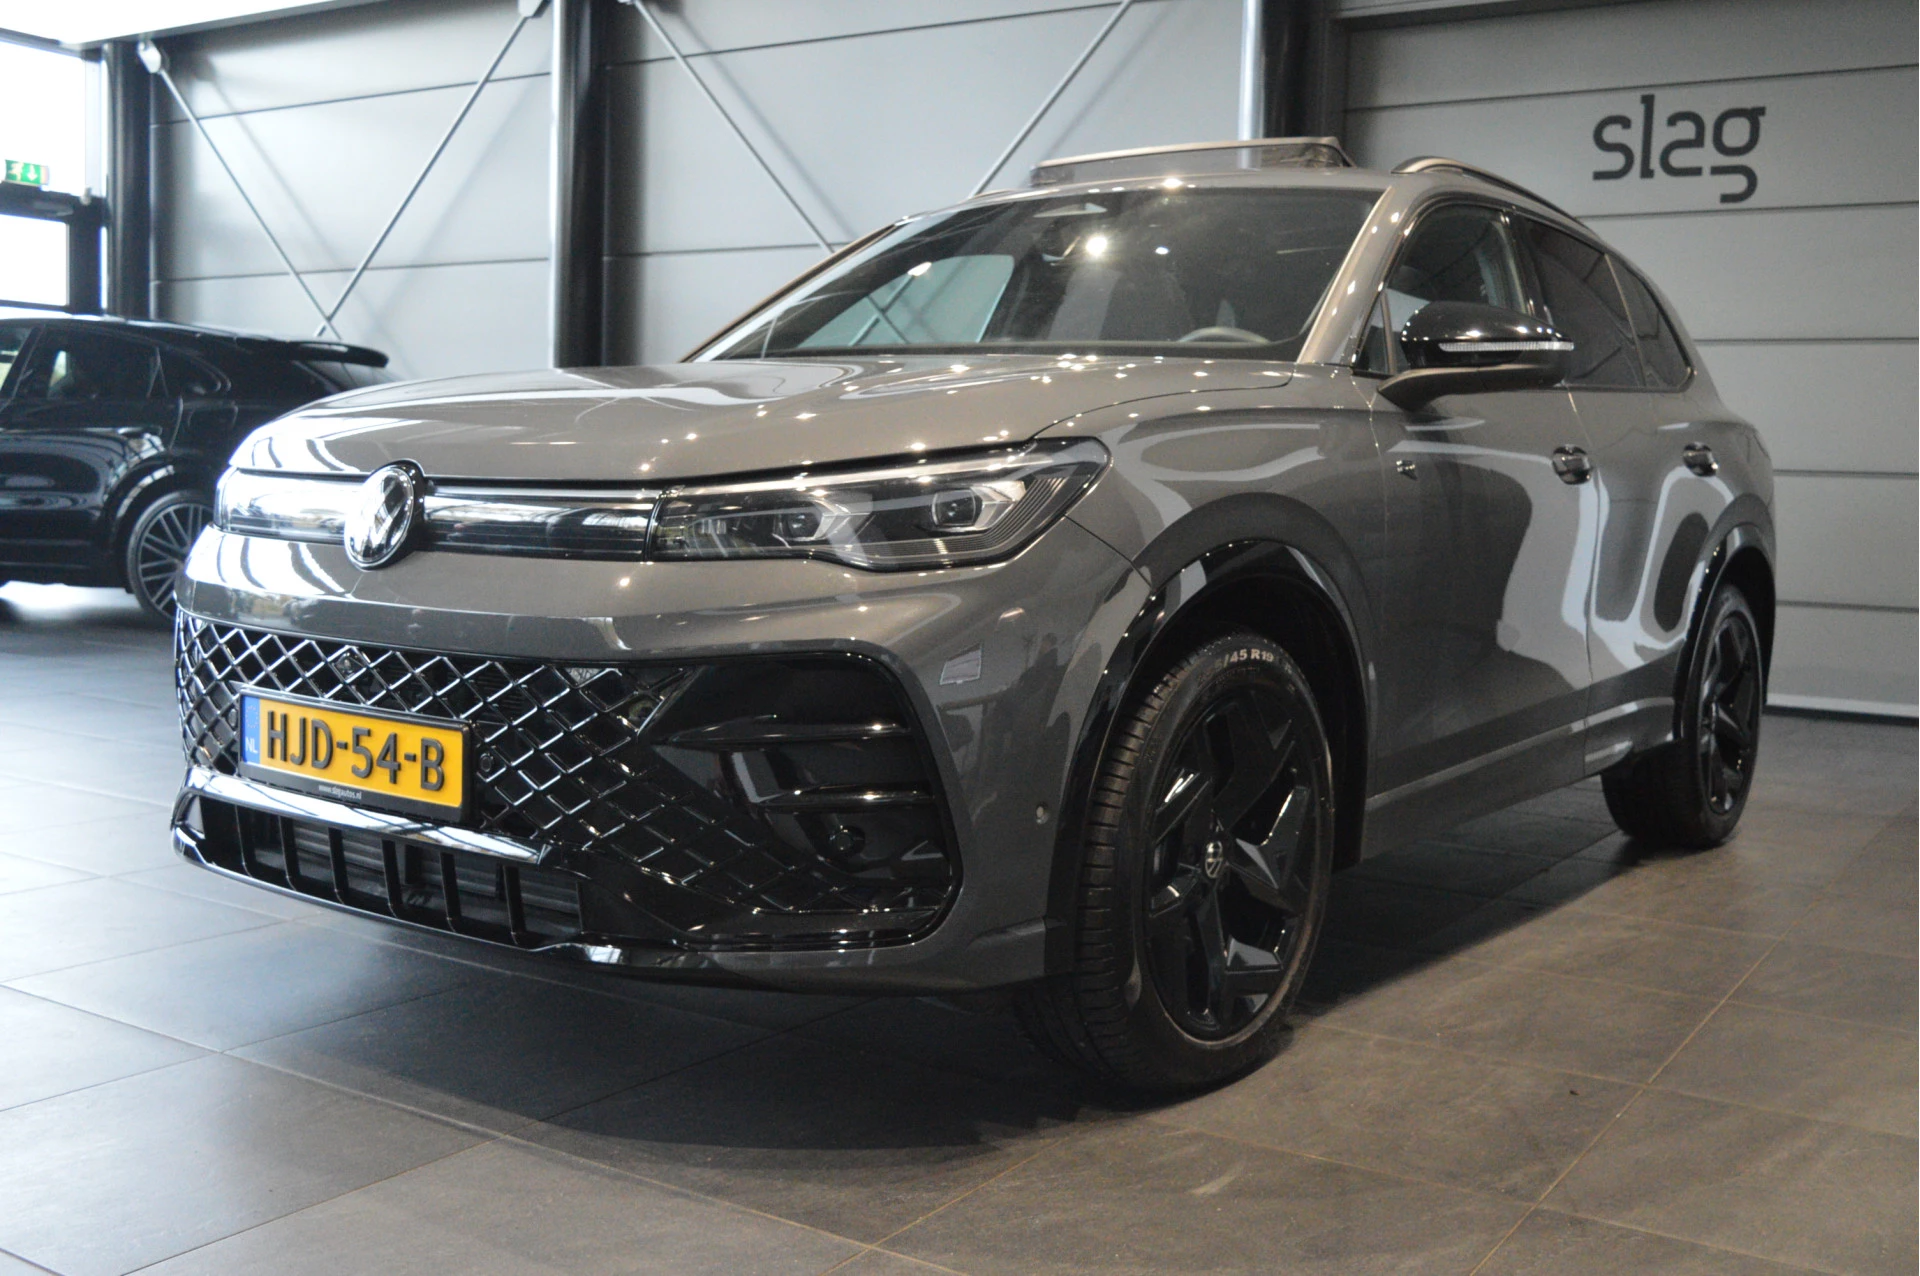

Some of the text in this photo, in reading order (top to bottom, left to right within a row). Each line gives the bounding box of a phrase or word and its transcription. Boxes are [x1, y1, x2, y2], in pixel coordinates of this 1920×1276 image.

[1592, 94, 1766, 203] slag
[245, 736, 259, 754] NL
[267, 710, 445, 791] HJD-54-B
